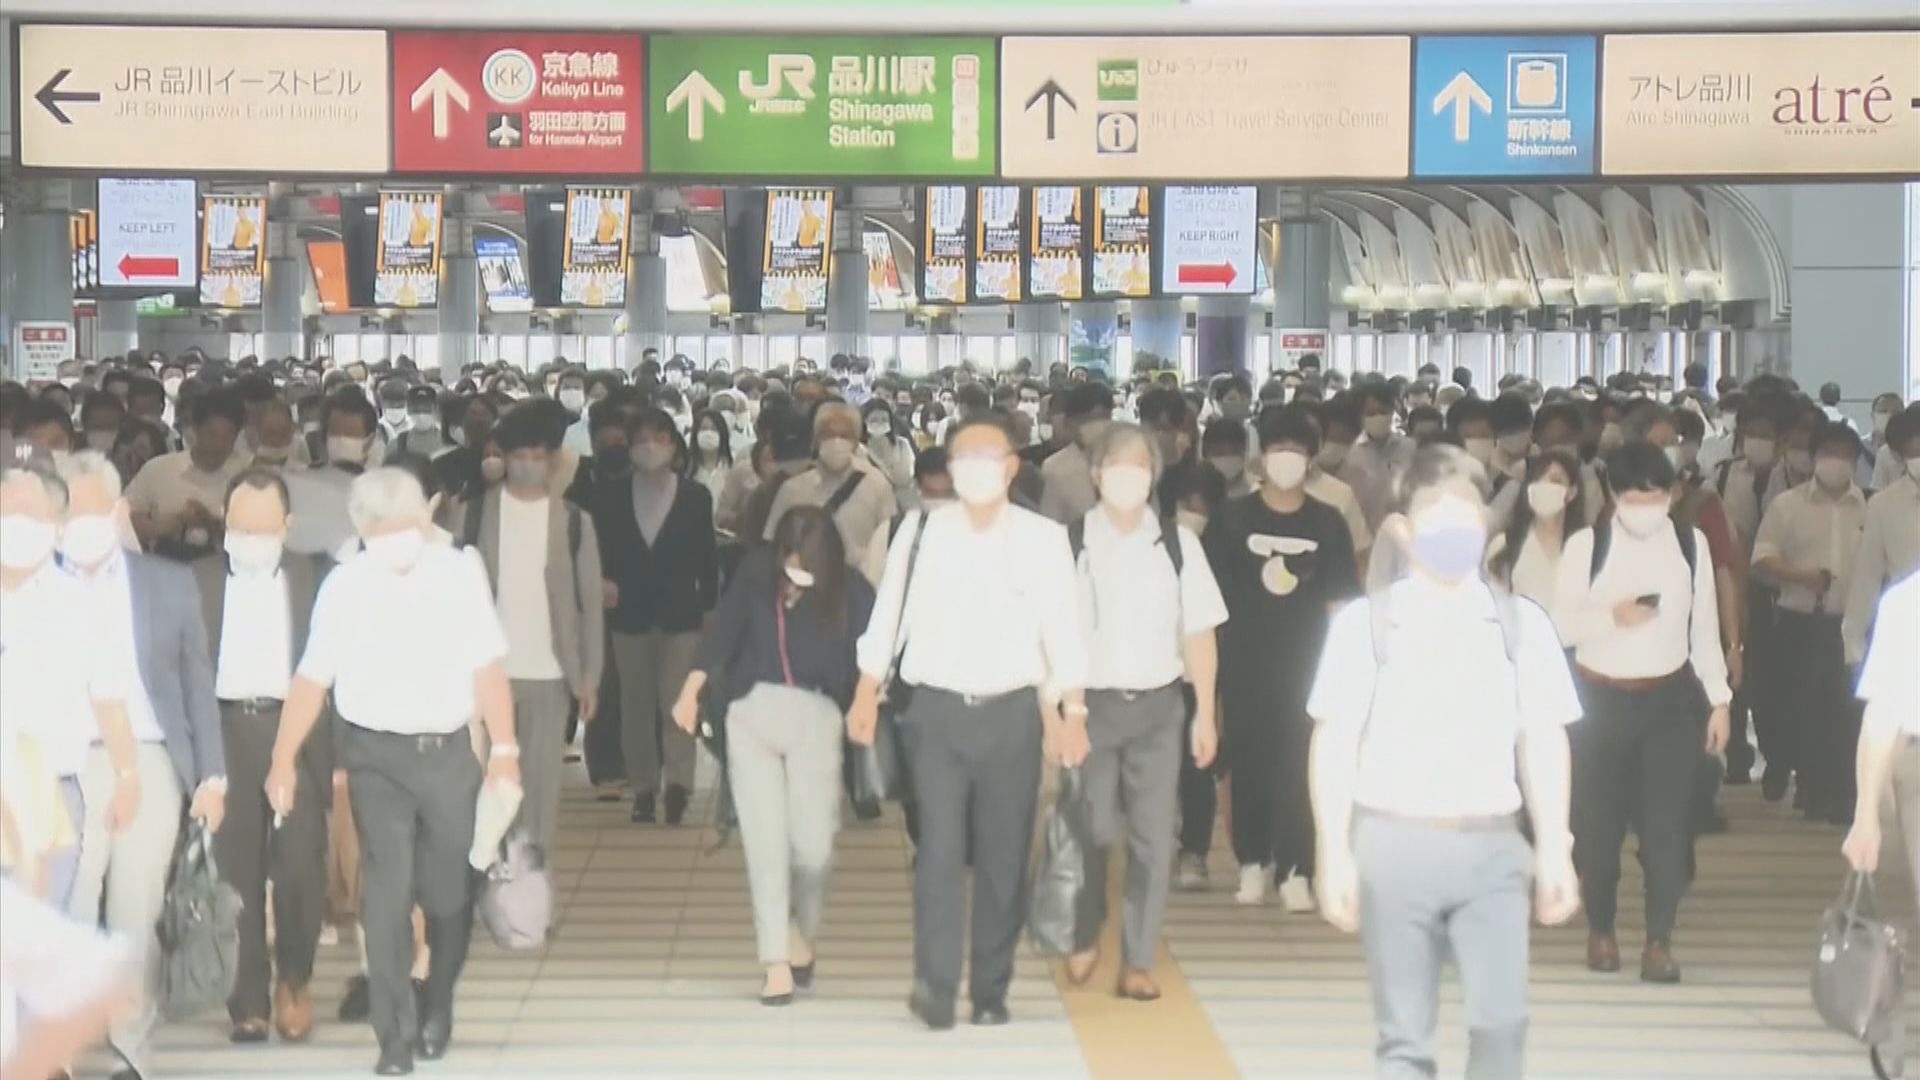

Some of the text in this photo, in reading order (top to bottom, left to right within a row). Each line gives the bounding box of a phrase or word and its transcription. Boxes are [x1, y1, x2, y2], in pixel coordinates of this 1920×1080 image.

[494, 67, 524, 87] KK
[541, 51, 619, 79] 京急線
[738, 54, 817, 99] JR
[828, 55, 937, 95] 品川駅
[160, 66, 363, 96] 品川イーストビル
[593, 82, 624, 97] Line
[1629, 73, 1752, 103] アトレ品川
[1771, 73, 1893, 124] atré
[828, 98, 934, 126] Shinagawa
[587, 133, 623, 148] Airport
[828, 124, 897, 148] Station
[1507, 142, 1578, 157] Shinkansen
[119, 222, 176, 233] KEEP LEFT
[1179, 230, 1241, 241] KEEP RIGHT
